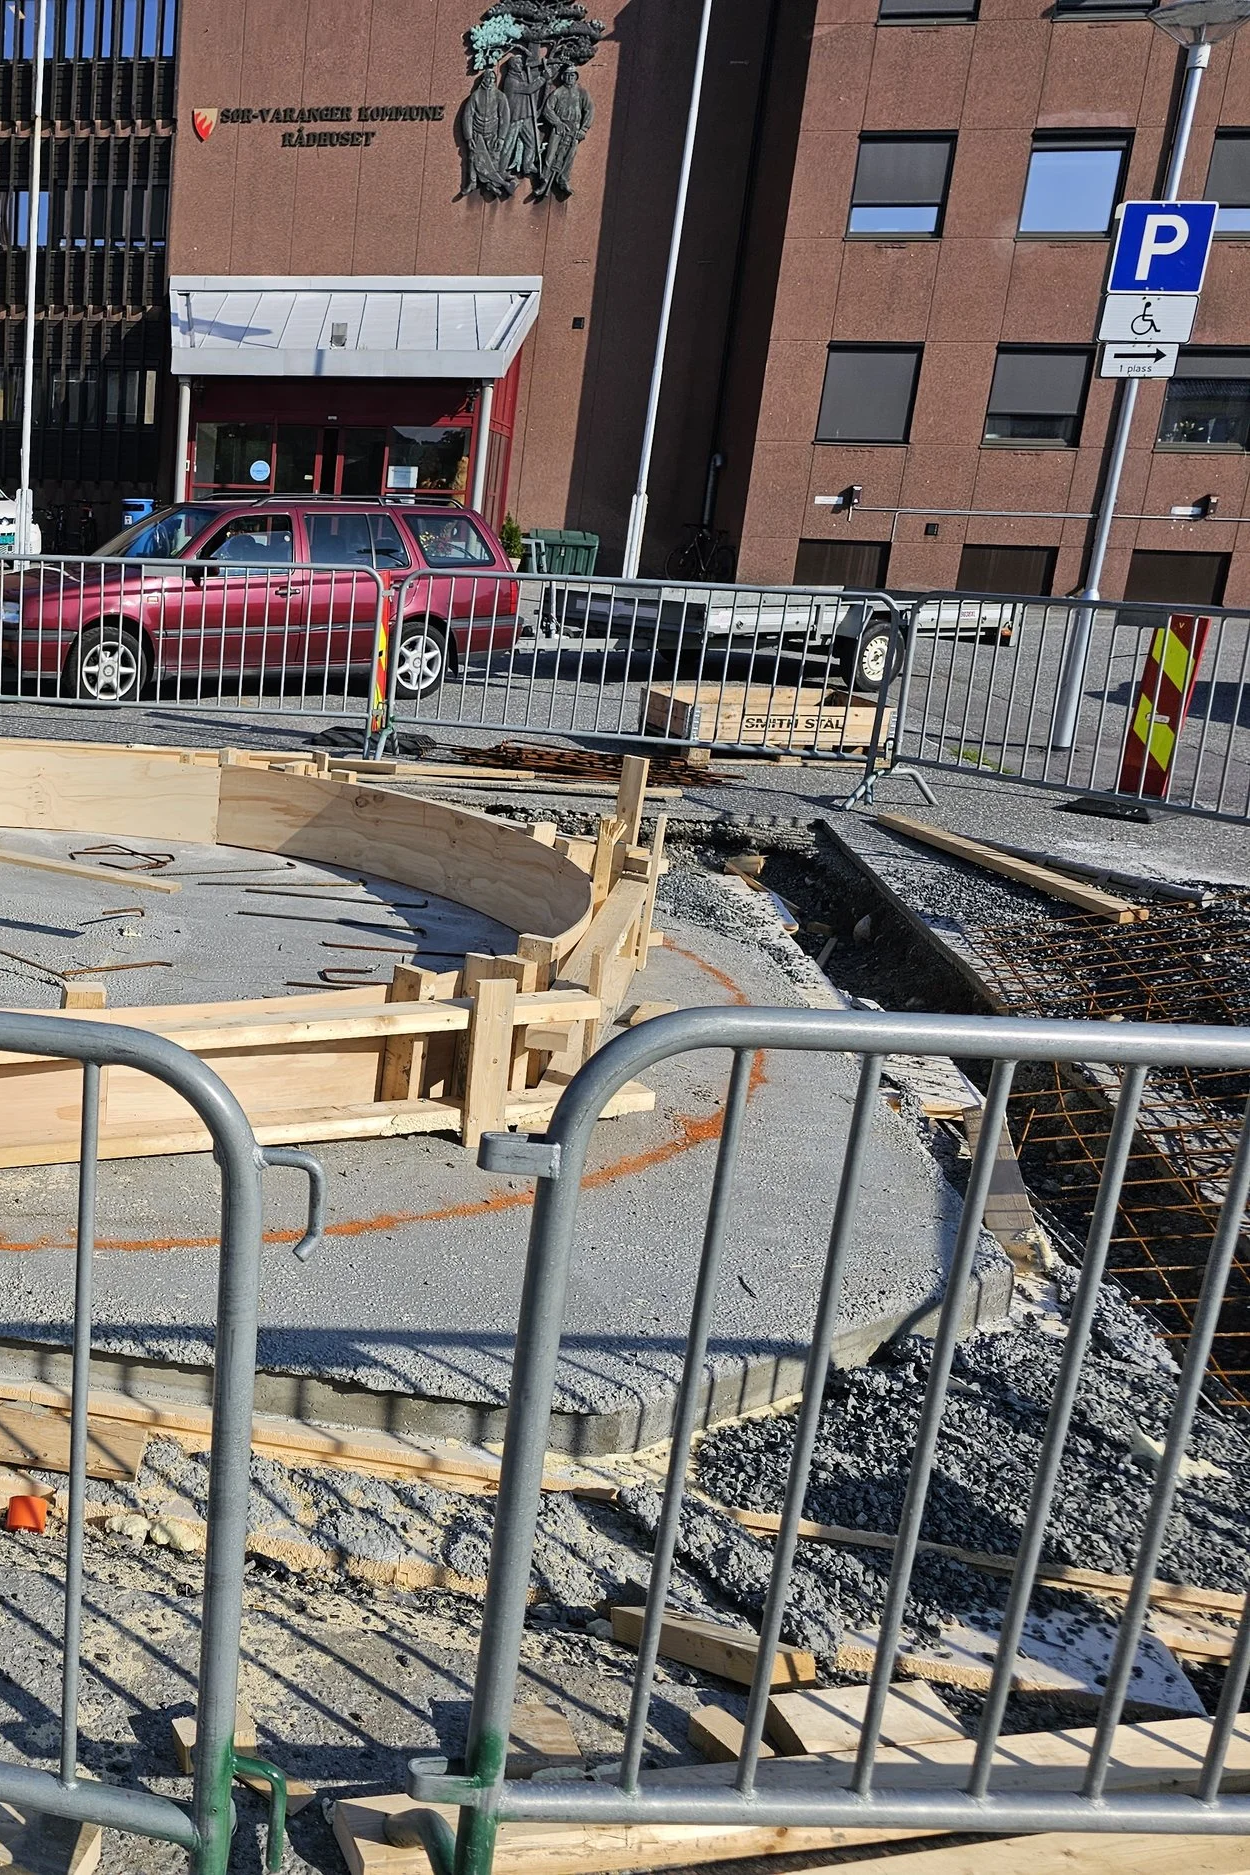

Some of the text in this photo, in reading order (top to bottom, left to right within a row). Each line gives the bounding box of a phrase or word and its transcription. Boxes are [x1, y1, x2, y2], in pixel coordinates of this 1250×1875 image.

[220, 104, 445, 123] SØR-VARANGER KOMMUNE
[281, 126, 376, 147] RÅDHUSET
[1135, 214, 1190, 281] P
[1127, 365, 1152, 374] plass
[744, 718, 844, 729] SMITH STÅL
